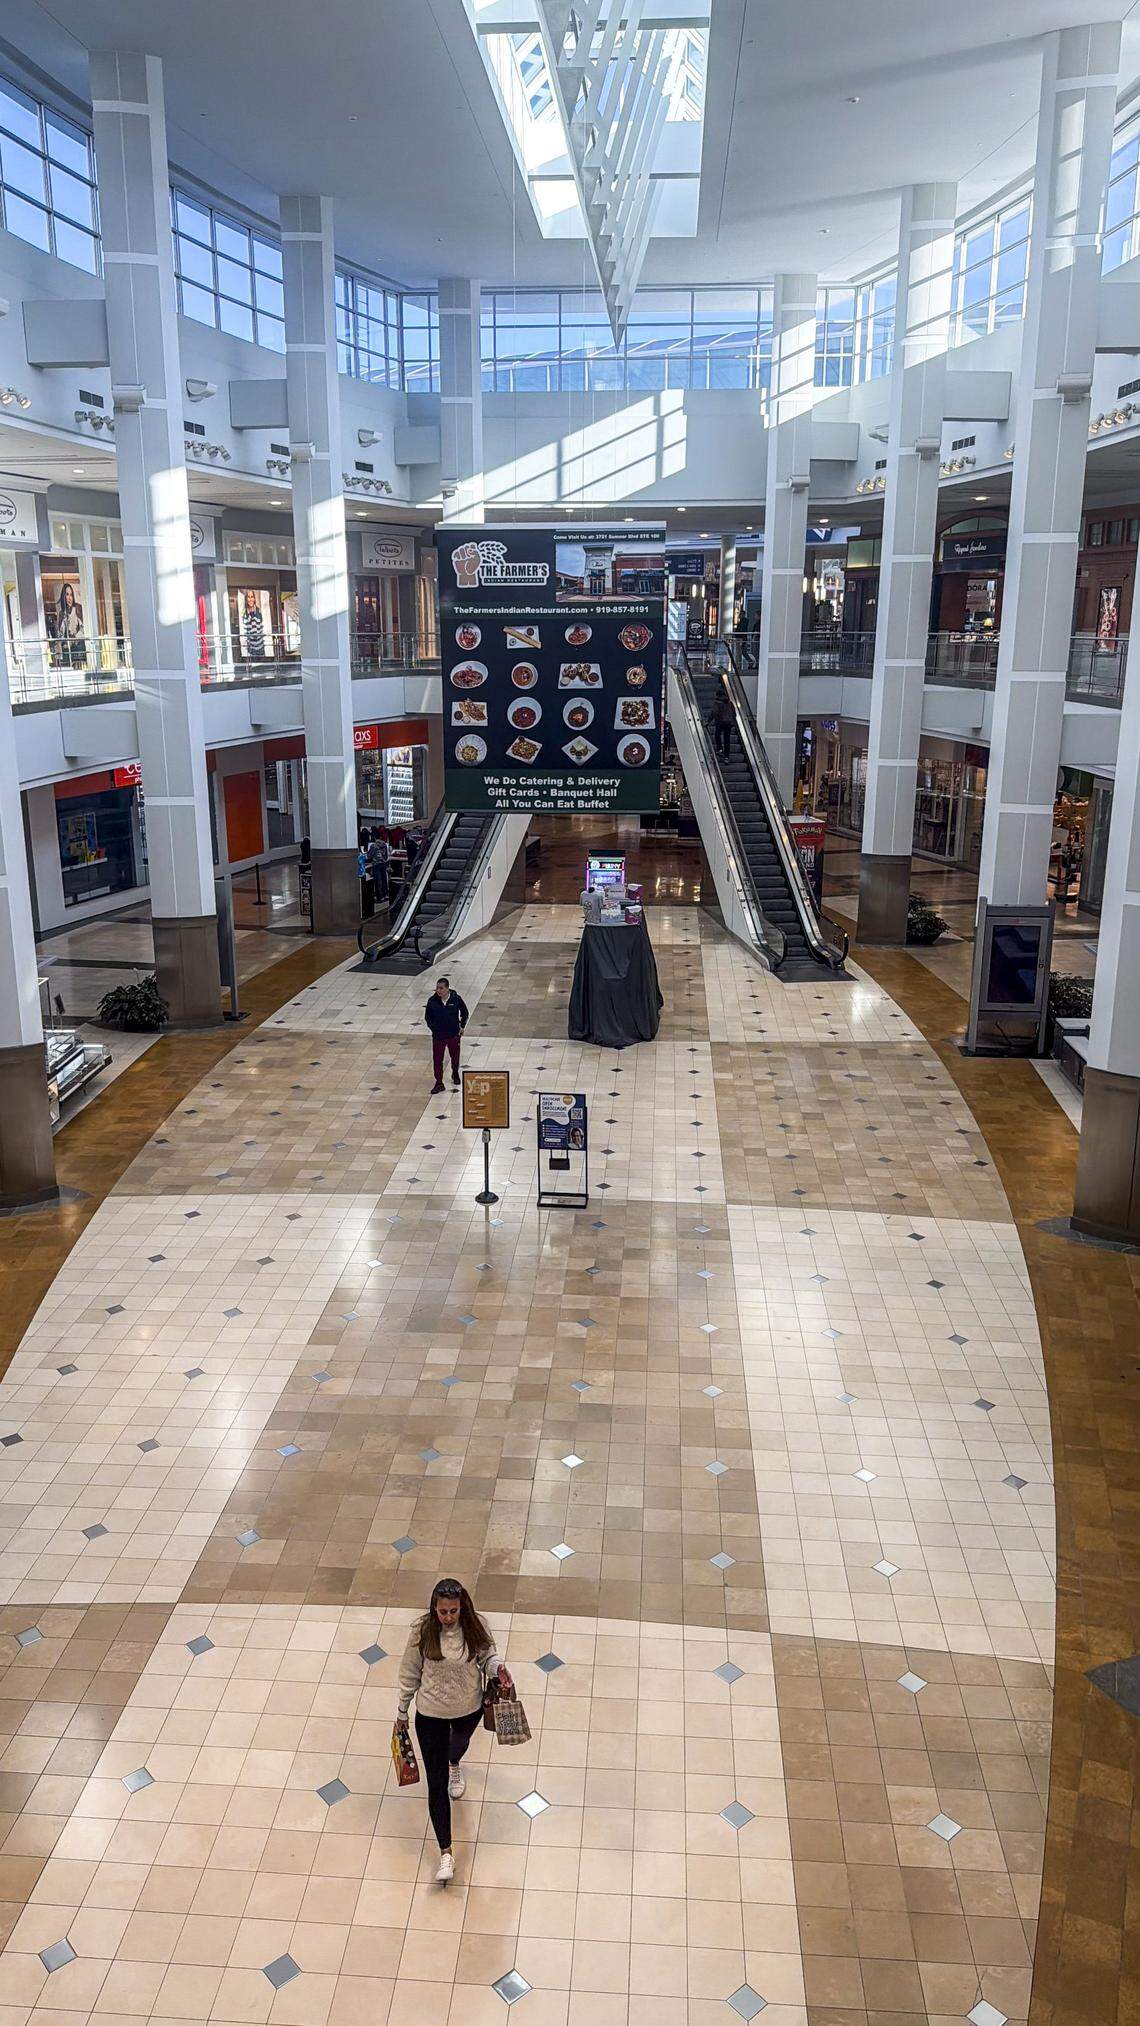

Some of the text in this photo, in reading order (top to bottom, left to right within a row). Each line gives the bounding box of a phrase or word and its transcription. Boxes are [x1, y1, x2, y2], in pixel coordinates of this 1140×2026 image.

[480, 565, 547, 577] THE FARMER'S
[484, 776, 620, 787] We Do Catering & Delivery
[488, 788, 506, 796] Gift
[550, 788, 594, 798] Banquet
[496, 800, 509, 808] All
[512, 800, 531, 808] You
[558, 800, 574, 808] Eat
[578, 800, 609, 808] Buffet
